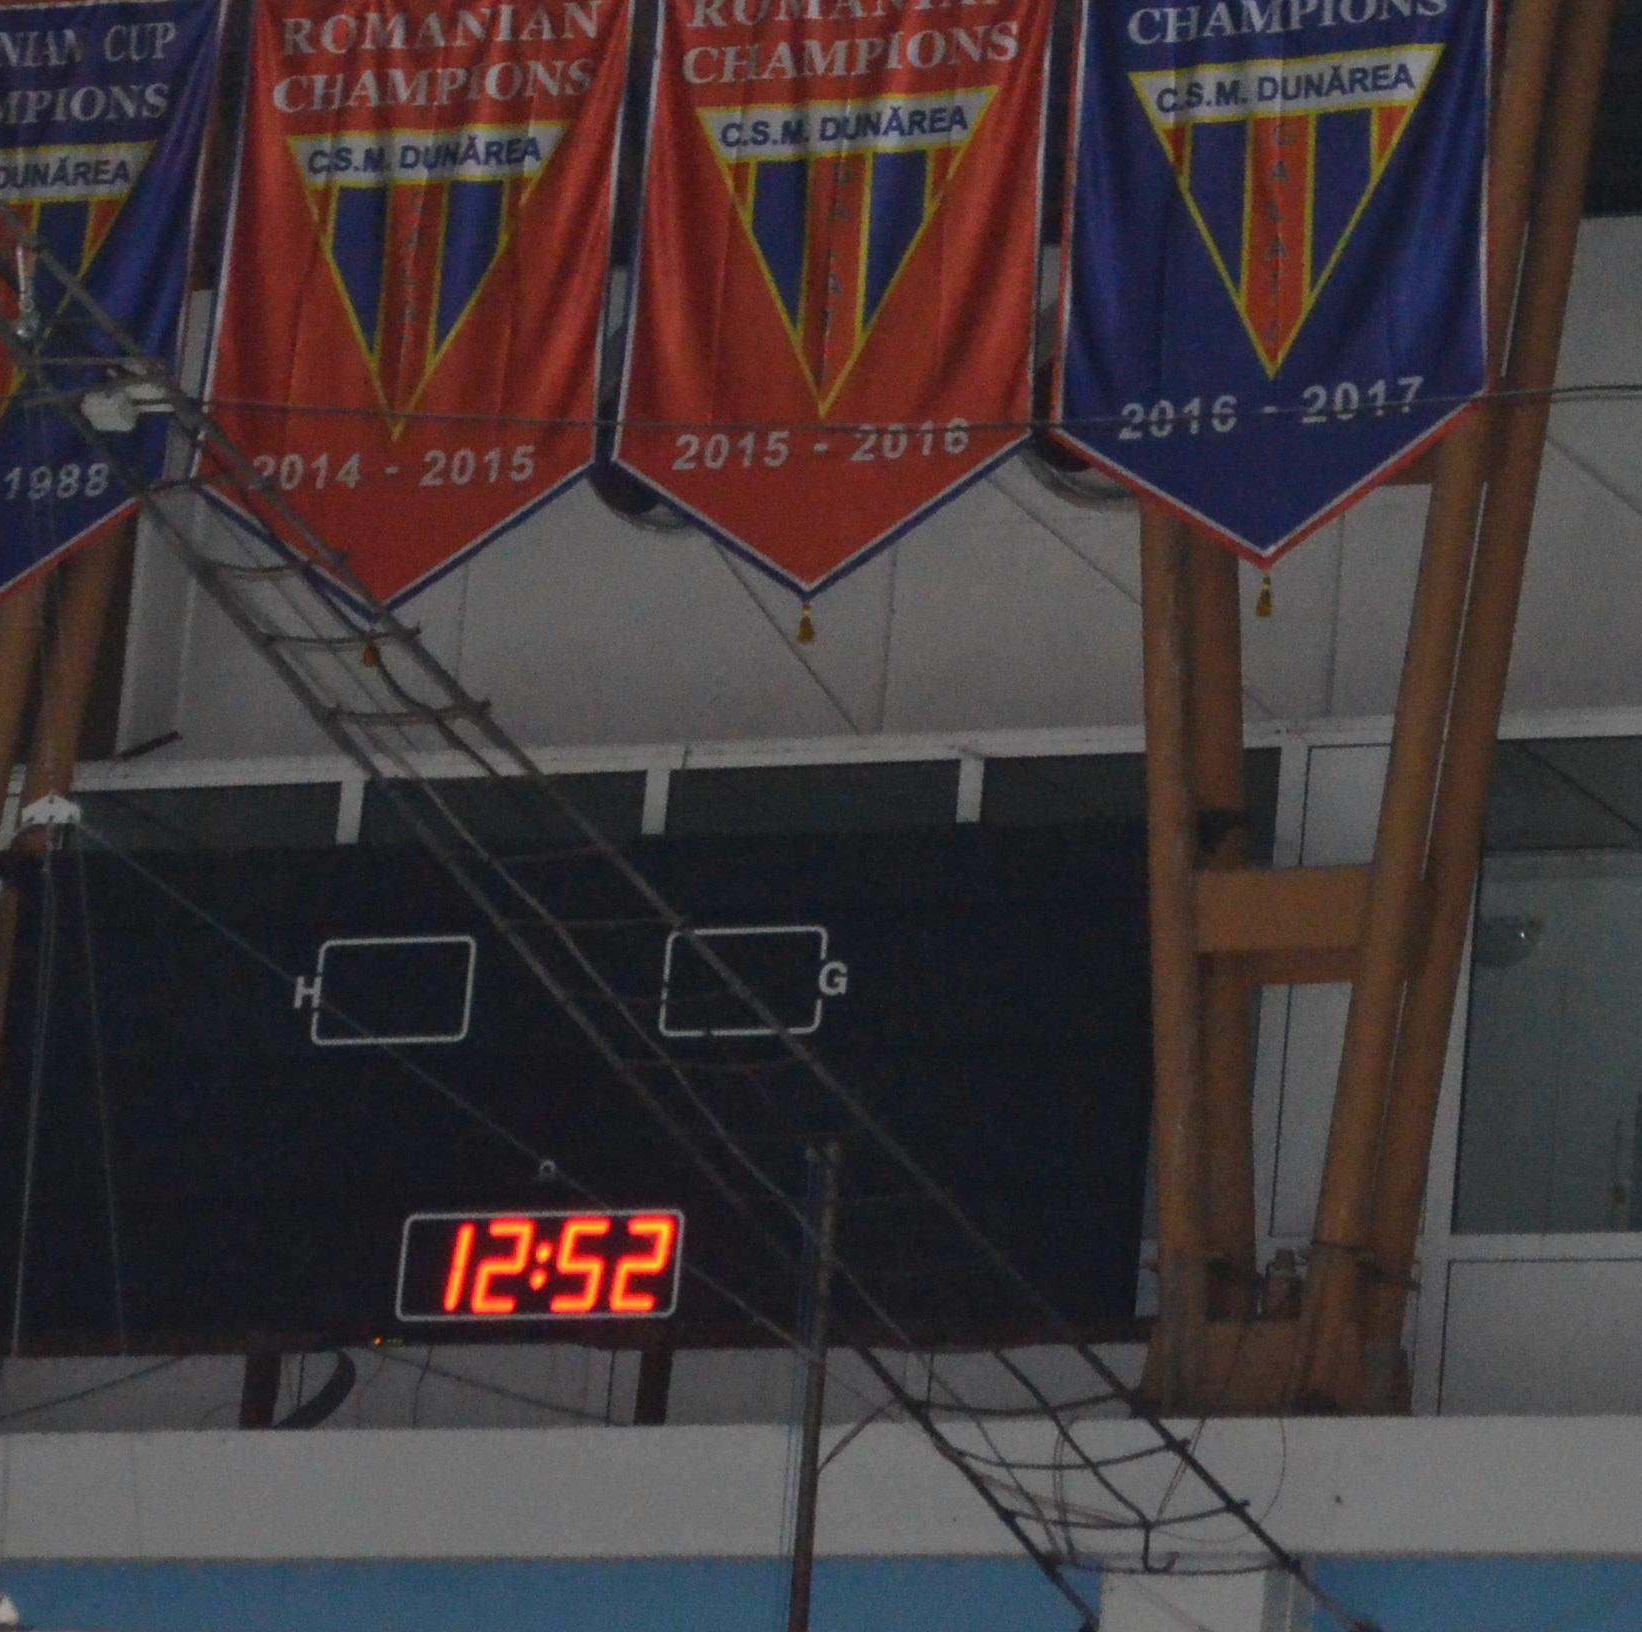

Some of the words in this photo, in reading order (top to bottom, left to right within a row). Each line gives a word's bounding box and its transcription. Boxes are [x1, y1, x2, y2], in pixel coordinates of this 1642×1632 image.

[104, 21, 176, 62] CUP
[282, 0, 603, 56] ROMANIAN
[681, 21, 1020, 85] CHAMPIONS
[272, 58, 596, 114] CHAMPIONS
[1156, 80, 1249, 113] C.S.M.
[720, 118, 810, 148] C.S.M.
[1118, 394, 1238, 440] 2016
[1263, 404, 1279, 415] -
[1301, 375, 1425, 424] 2017
[248, 451, 362, 491] 2014
[383, 464, 400, 475] -
[419, 444, 536, 487] 2015
[671, 429, 790, 471] 2015
[813, 441, 829, 454] -
[850, 417, 970, 462] 2016
[3, 461, 110, 500] 1988
[293, 974, 323, 1010] H
[818, 960, 848, 996] G
[443, 1215, 677, 1315] 12:52
